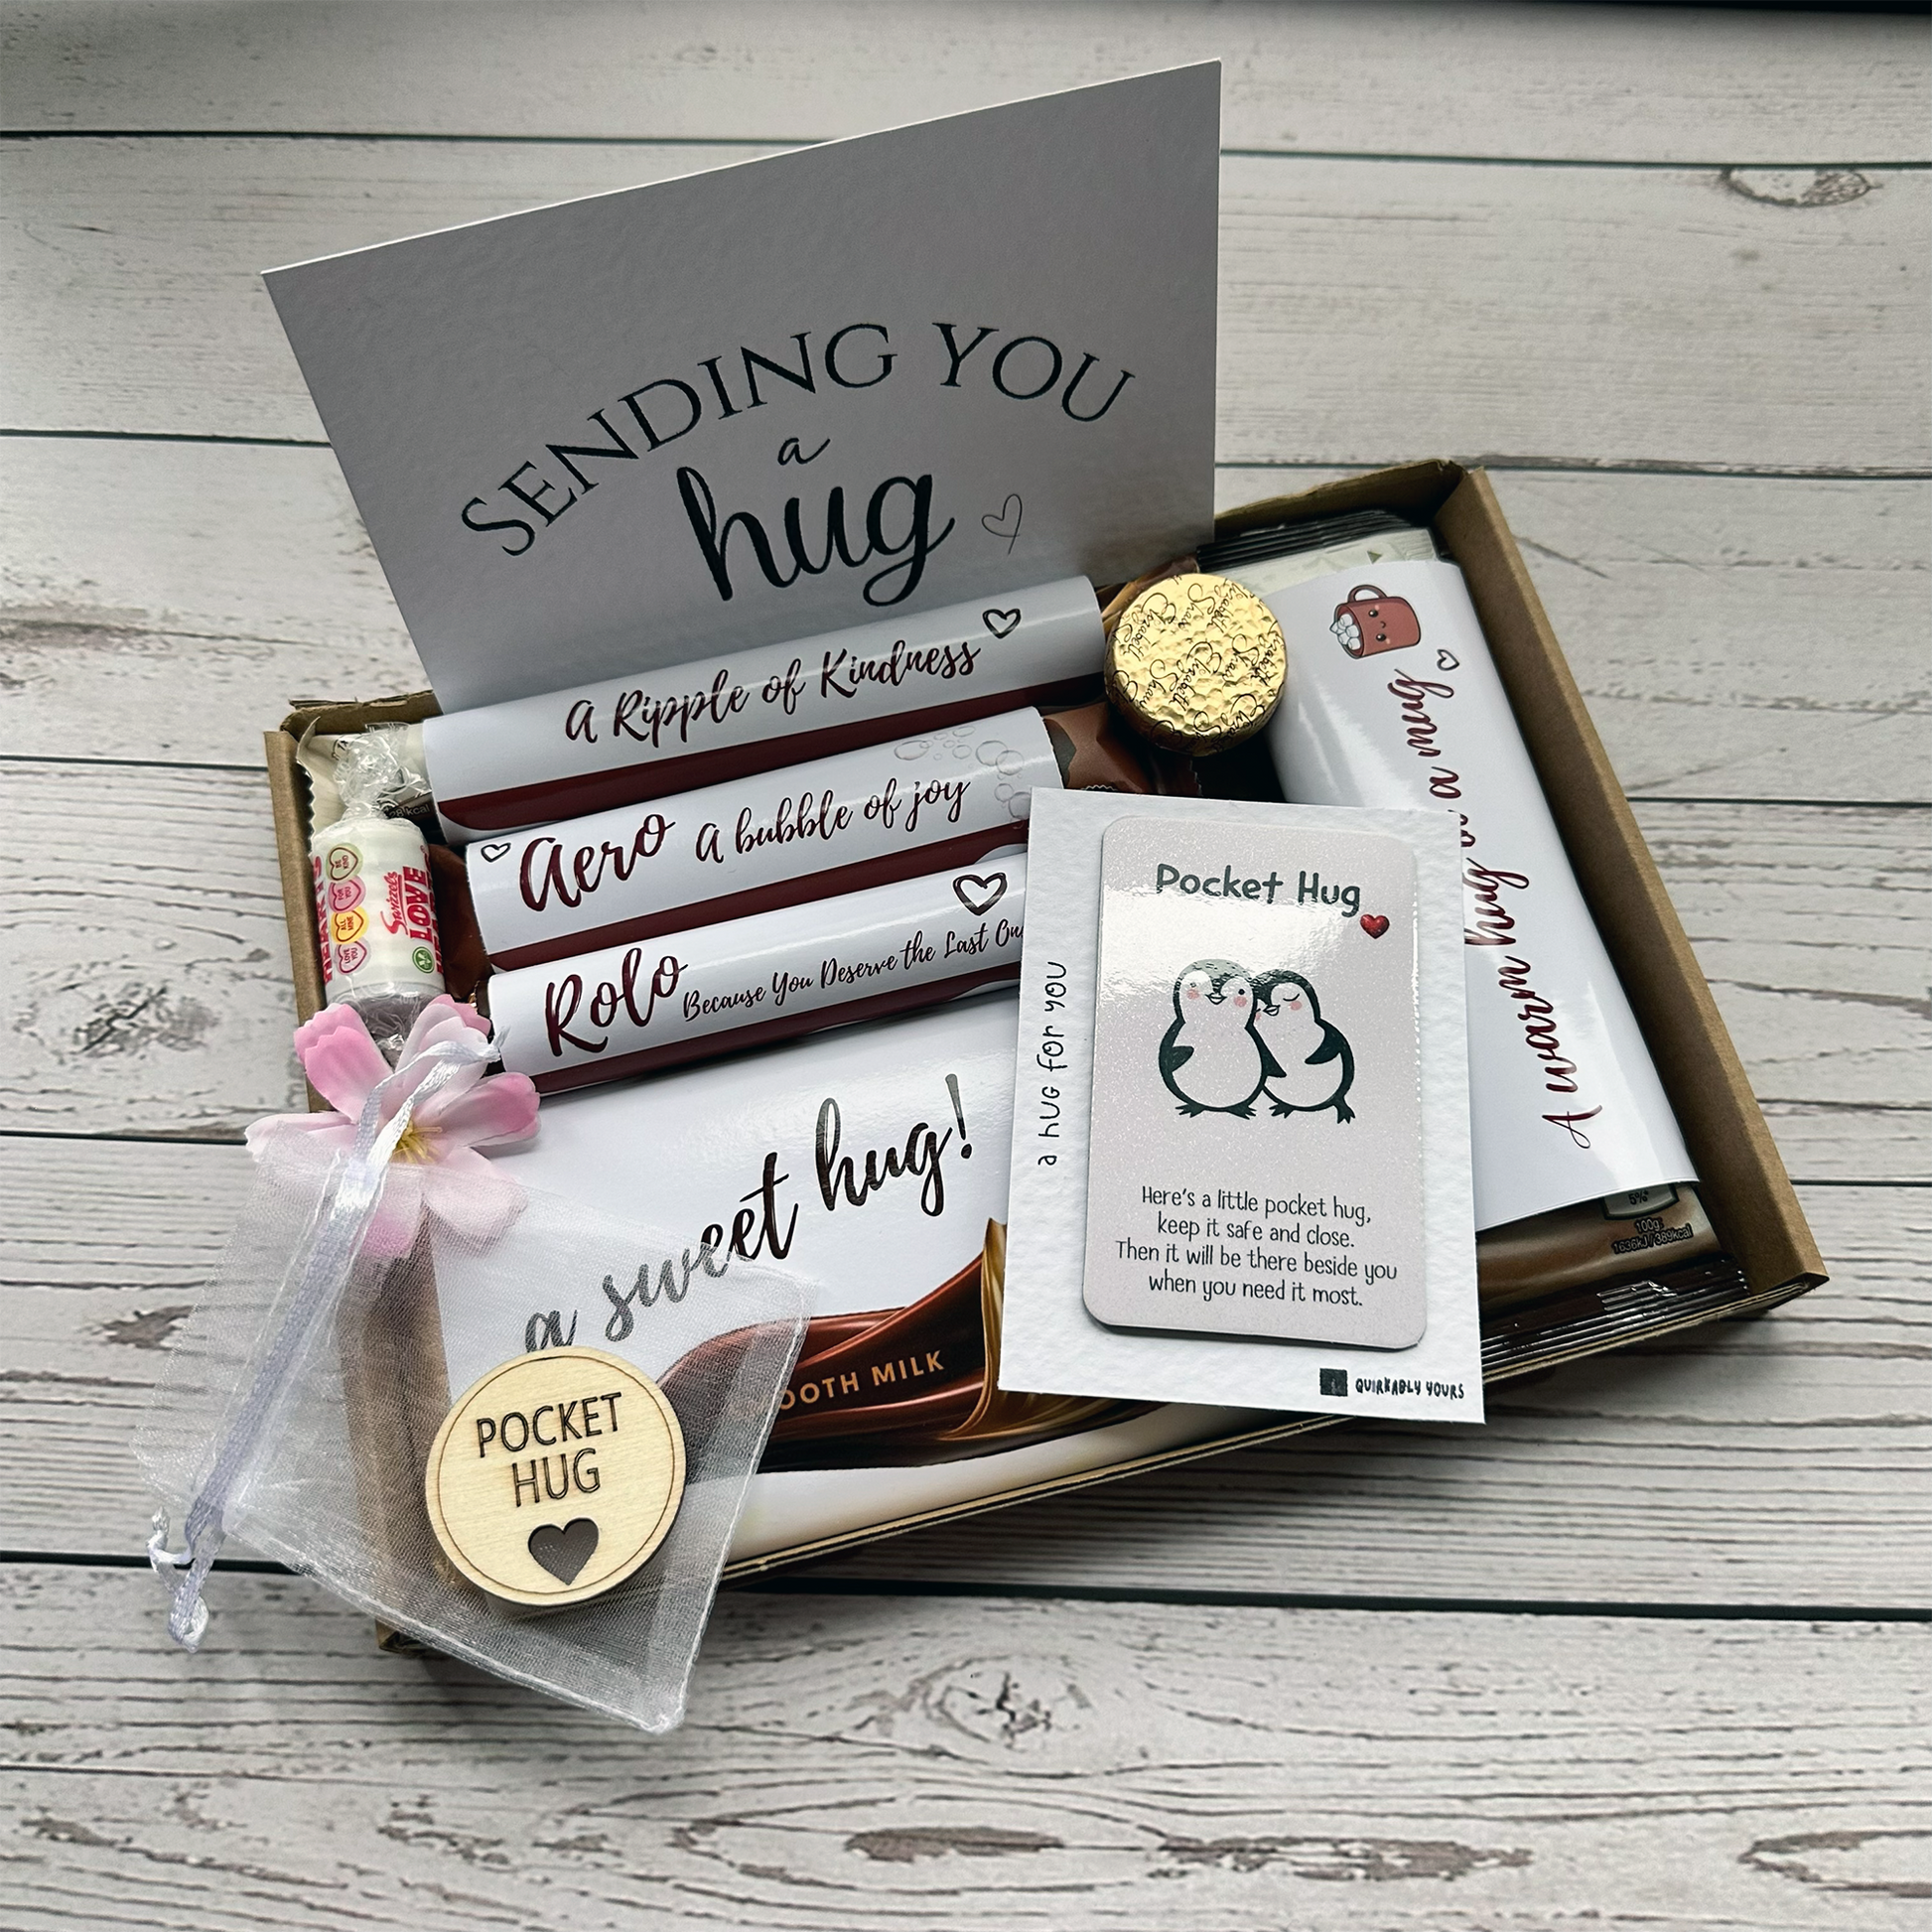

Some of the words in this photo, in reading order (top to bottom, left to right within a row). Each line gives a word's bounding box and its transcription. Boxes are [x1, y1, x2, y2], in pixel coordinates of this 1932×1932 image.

[461, 323, 897, 556] SENDING
[931, 323, 1136, 422] YOU
[776, 436, 830, 466] a
[675, 467, 955, 607] hug
[565, 700, 598, 743] A
[613, 669, 750, 748] Ripple
[761, 659, 806, 715] of
[820, 639, 982, 698] Kindness
[1388, 669, 1455, 757] mug
[1429, 766, 1462, 799] a
[518, 813, 676, 910] Aero
[696, 822, 724, 863] A
[735, 789, 854, 855] bubble
[864, 777, 902, 829] of
[905, 777, 970, 833] joy
[402, 866, 433, 943] LOVE
[1156, 864, 1283, 904] Pocket
[1298, 870, 1361, 918] Hug
[1461, 857, 1530, 946] hug
[543, 947, 689, 1056] Rolo
[682, 985, 766, 1022] Because
[770, 971, 814, 1005] You
[820, 954, 898, 990] Deserve
[898, 930, 936, 963] the
[944, 922, 989, 958] Last
[1497, 956, 1579, 1093] warm
[1541, 1104, 1602, 1149] A
[524, 1309, 579, 1352] a
[602, 1151, 799, 1342] sweet
[814, 1073, 973, 1217] hug!
[1142, 1185, 1195, 1207] Here's
[1201, 1193, 1211, 1208] a
[1217, 1188, 1259, 1212] little
[1265, 1192, 1327, 1219] pocket
[1333, 1195, 1372, 1227] hug,
[1158, 1211, 1200, 1242] keep
[1206, 1217, 1220, 1237] it
[1226, 1220, 1263, 1240] safe
[1269, 1223, 1300, 1243] and
[1307, 1224, 1355, 1248] close.
[1116, 1237, 1160, 1262] Then
[1166, 1243, 1179, 1263] it
[1186, 1244, 1214, 1266] will
[1220, 1245, 1241, 1268] be
[1247, 1246, 1298, 1272] there
[1304, 1252, 1358, 1277] beside
[1364, 1264, 1398, 1286] you
[1149, 1268, 1196, 1293] when
[1202, 1280, 1236, 1302] you
[1242, 1279, 1285, 1300] need
[1292, 1282, 1306, 1302] it
[1312, 1286, 1363, 1307] most.
[780, 1372, 860, 1411] OOTH
[872, 1350, 945, 1387] MILK
[1426, 1379, 1464, 1400] YOURS
[476, 1392, 622, 1458] POCKET
[510, 1449, 601, 1509] HUG
